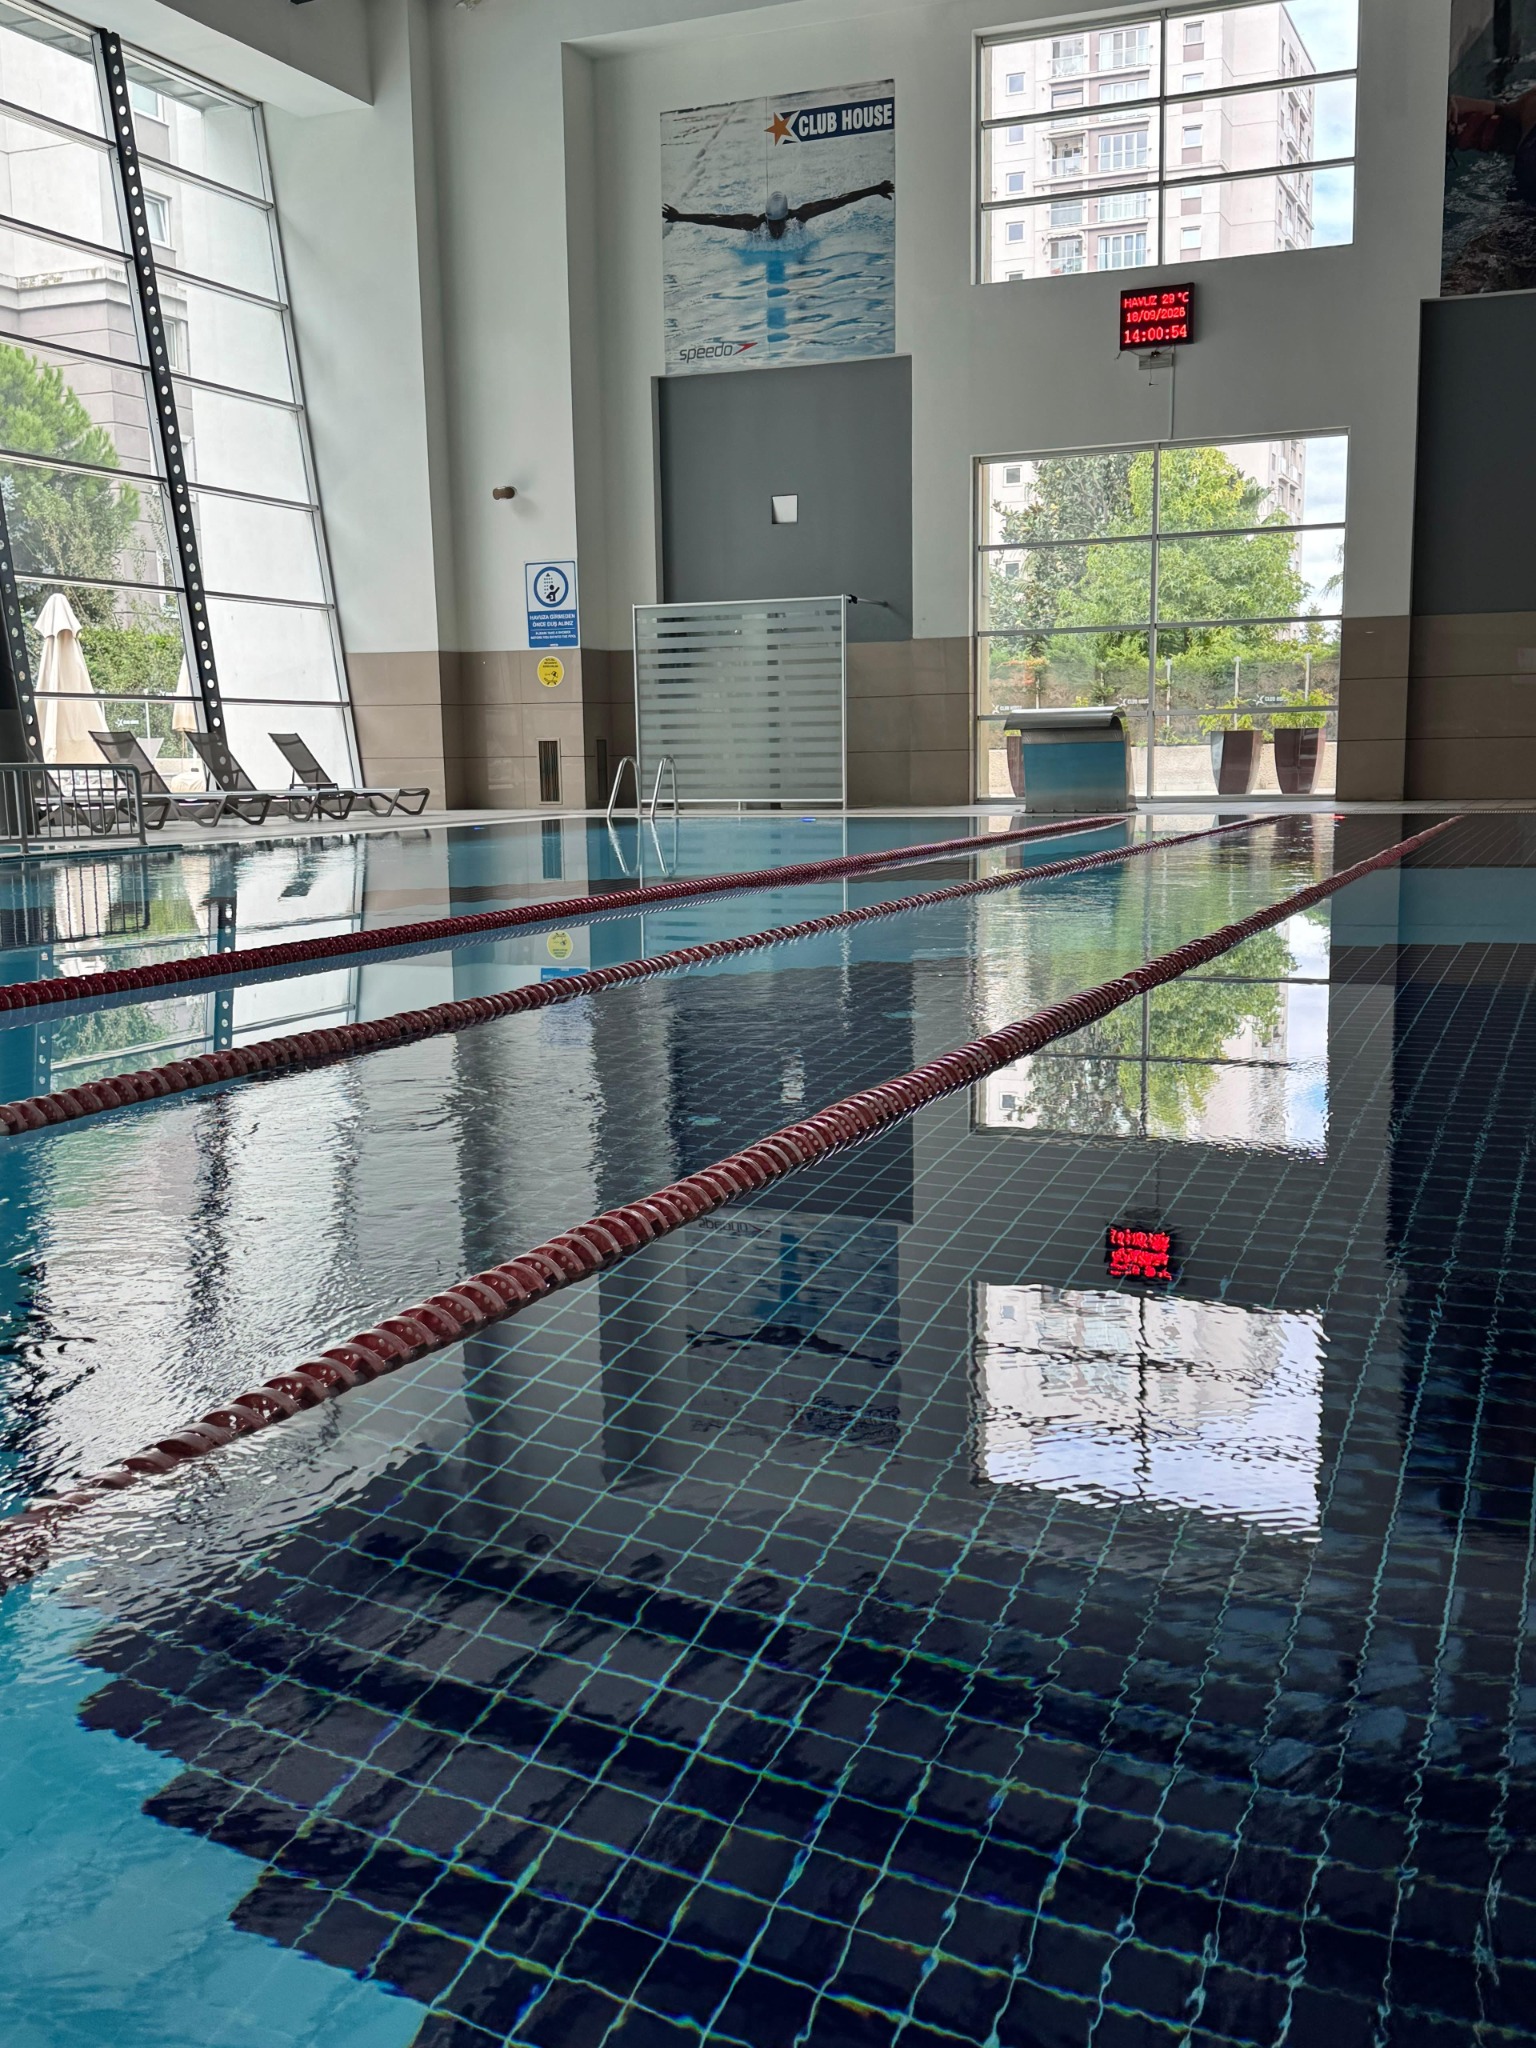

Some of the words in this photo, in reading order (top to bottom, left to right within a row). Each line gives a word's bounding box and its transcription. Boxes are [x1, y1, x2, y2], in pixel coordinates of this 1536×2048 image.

[798, 112, 837, 137] CLUB
[841, 103, 893, 131] HOUSE
[1123, 295, 1157, 308] HAVUZ
[1124, 324, 1187, 344] 14:00:54
[679, 342, 733, 364] speedo
